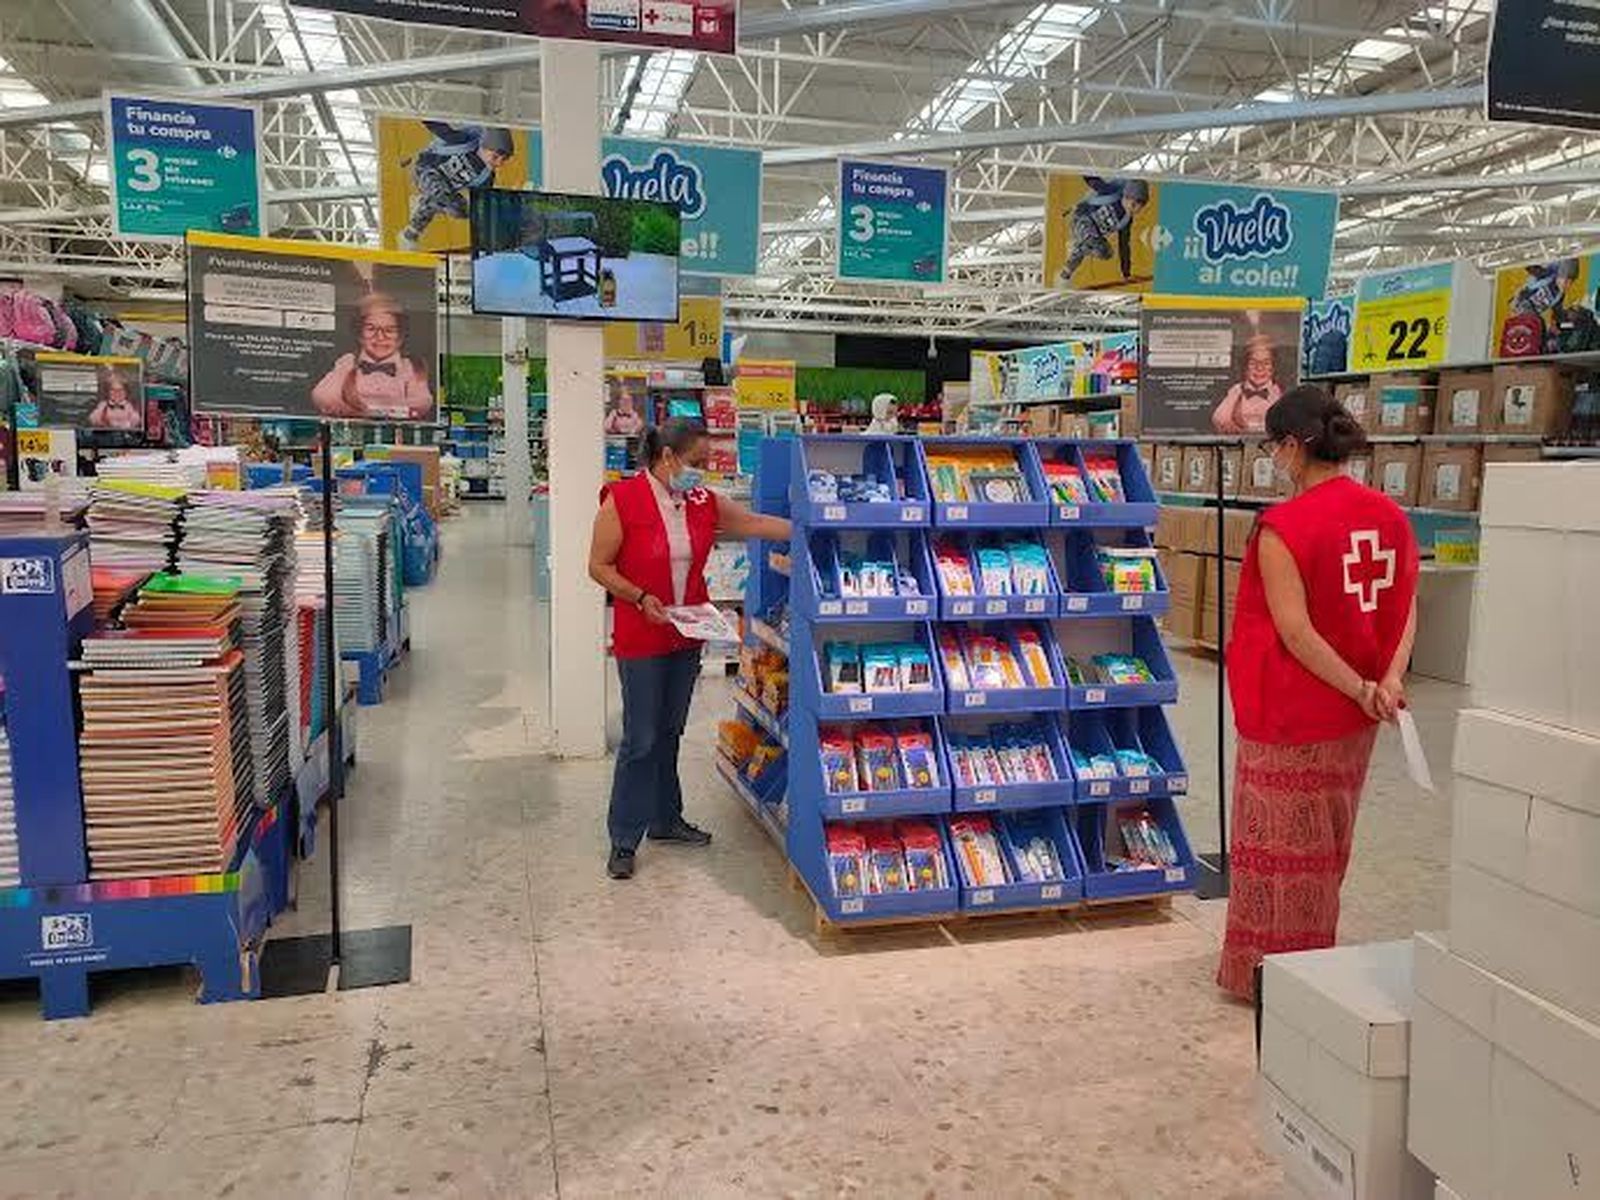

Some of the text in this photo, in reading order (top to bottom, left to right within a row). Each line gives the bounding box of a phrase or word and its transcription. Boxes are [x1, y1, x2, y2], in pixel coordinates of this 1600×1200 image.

[126, 107, 196, 126] Financia
[127, 123, 212, 142] tu compra
[127, 148, 162, 193] 3
[852, 168, 903, 184] Financia
[852, 182, 915, 199] tu compra
[849, 204, 875, 242] 3
[1199, 262, 1299, 289] al cole!!
